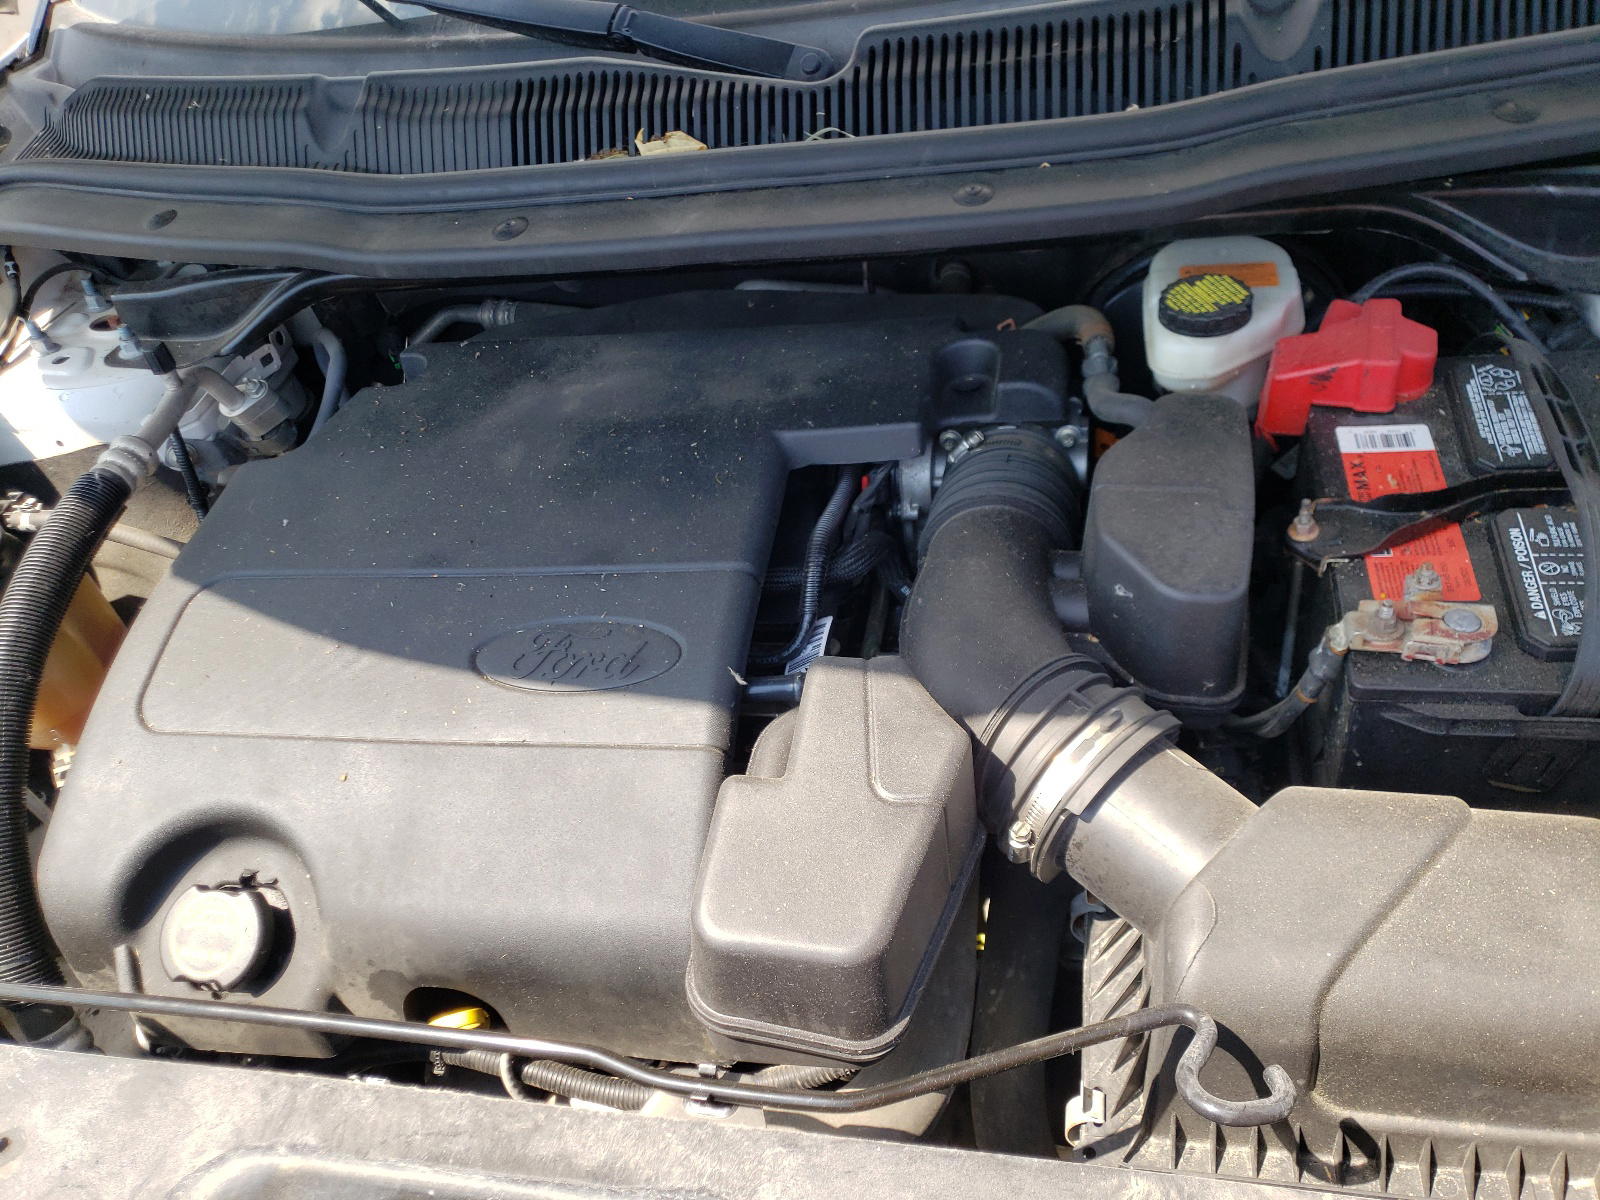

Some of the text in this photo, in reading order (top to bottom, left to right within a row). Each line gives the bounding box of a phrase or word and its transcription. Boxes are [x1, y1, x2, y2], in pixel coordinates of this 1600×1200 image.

[1508, 526, 1530, 562] POISON
[1521, 567, 1544, 610] DANGER
[507, 632, 650, 681] Ford
